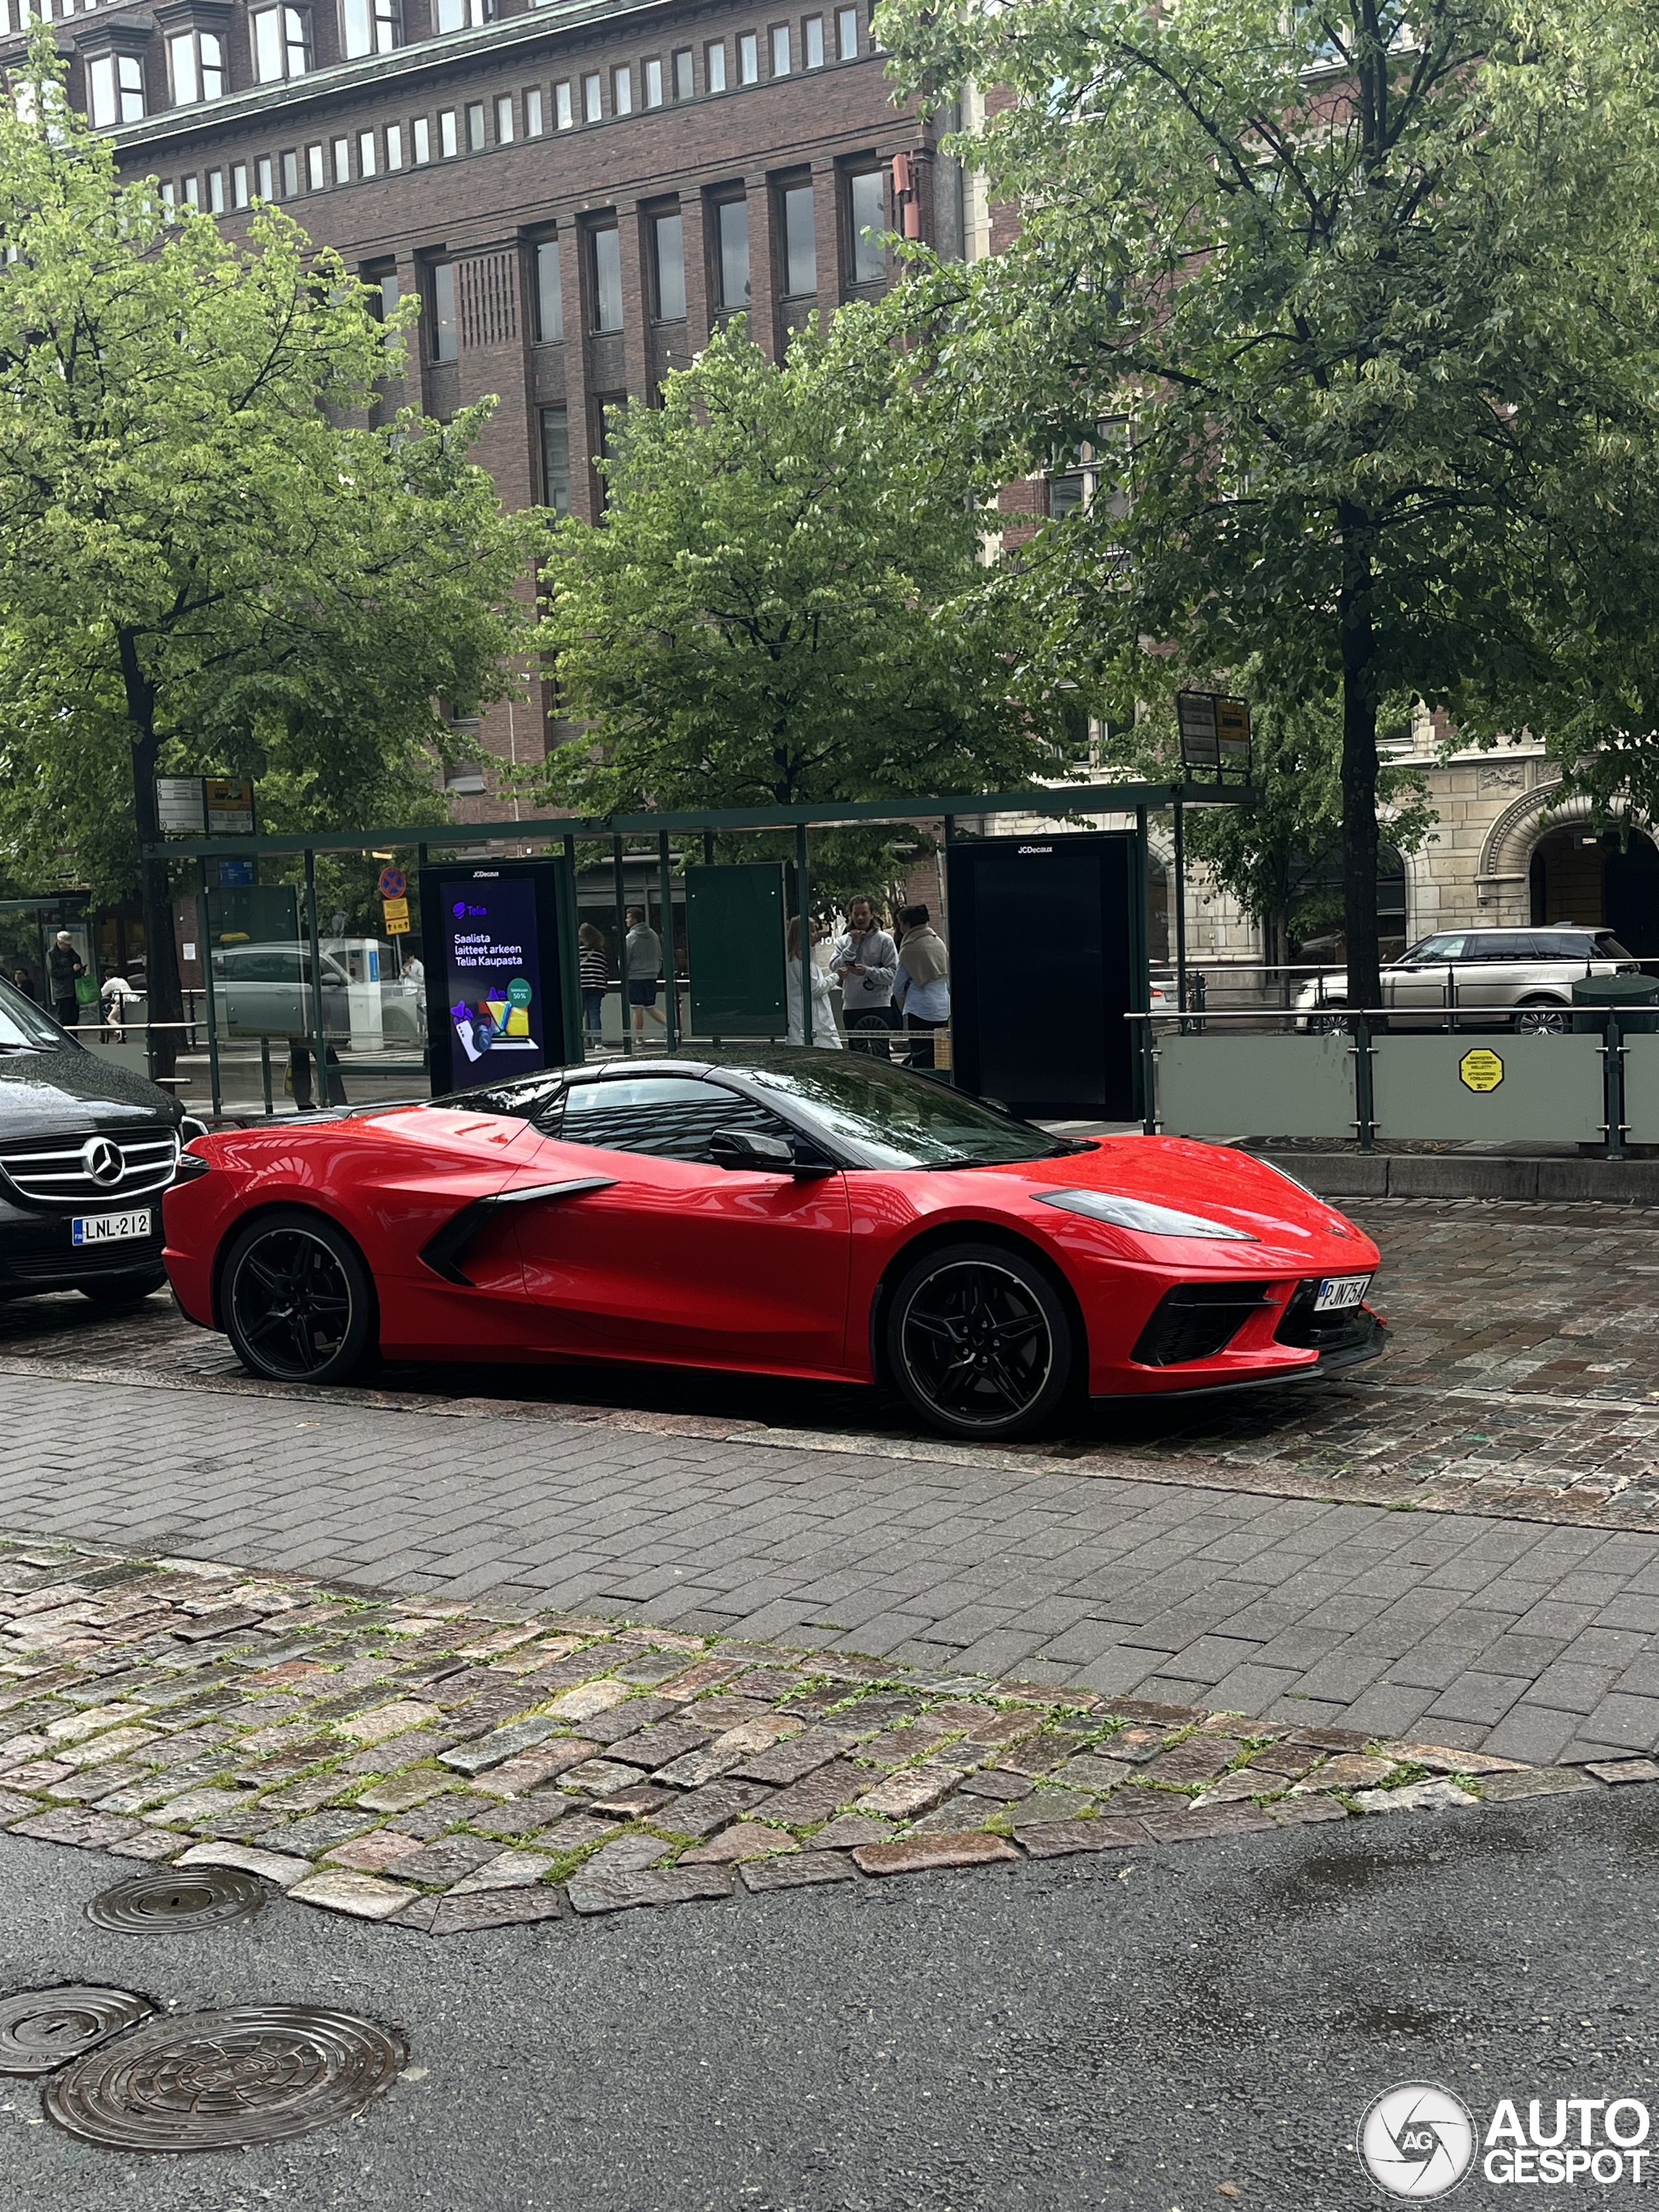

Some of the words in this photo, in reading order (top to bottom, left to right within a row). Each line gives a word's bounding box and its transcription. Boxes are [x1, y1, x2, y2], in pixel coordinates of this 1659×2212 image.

[467, 905, 487, 916] Telia
[454, 933, 491, 944] Saalista
[455, 945, 488, 955] laitteet
[489, 944, 522, 954] arkeen
[456, 957, 476, 966] Telia
[478, 956, 522, 967] Kaupasta
[86, 1215, 146, 1239] LNL-212
[1322, 1281, 1366, 1307] PJN75A
